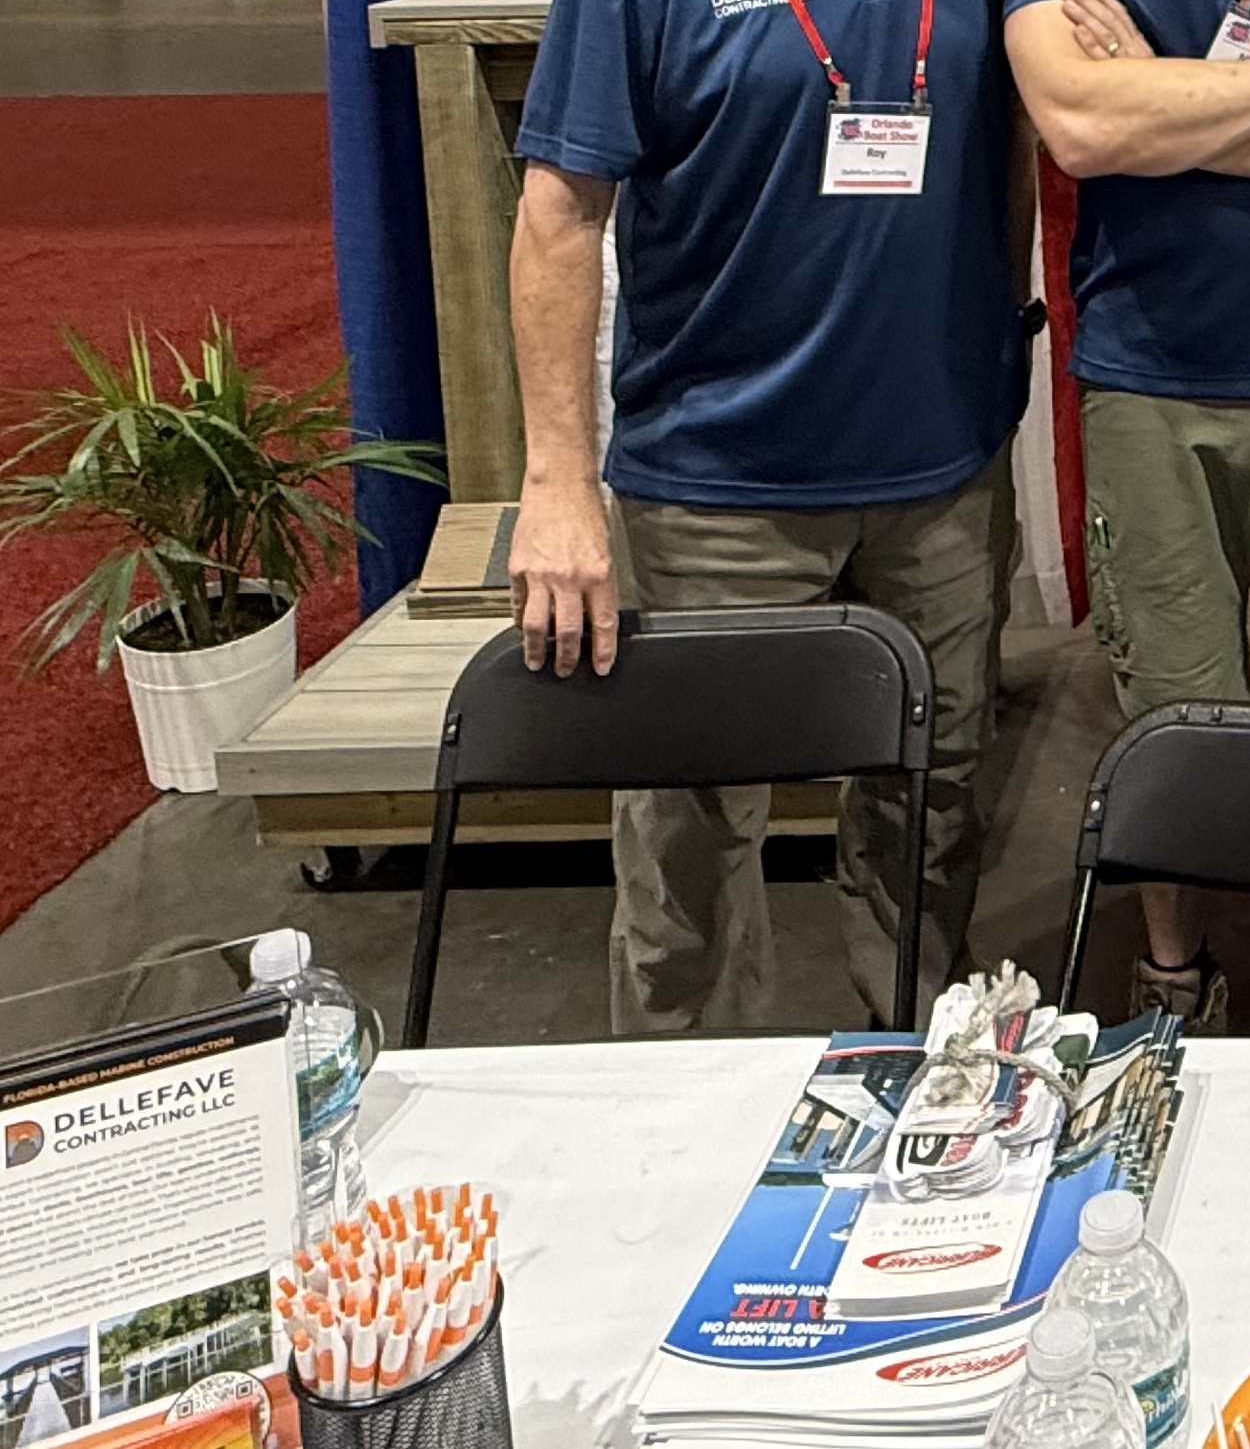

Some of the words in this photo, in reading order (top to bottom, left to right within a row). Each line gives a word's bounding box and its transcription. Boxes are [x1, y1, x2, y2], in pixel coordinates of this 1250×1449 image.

[871, 119, 913, 129] Orlando
[864, 131, 887, 140] Boat
[890, 131, 918, 141] Show
[867, 148, 887, 159] Roy
[2, 1072, 98, 1103] FLORIDA-BASED
[100, 1059, 145, 1079] MARINE
[146, 1036, 234, 1066] CONSTRUCTION
[54, 1068, 235, 1134] DELLEFAVE
[53, 1104, 196, 1153] CONTRACTING
[202, 1093, 235, 1113] LLC
[730, 1298, 798, 1319] LIFT
